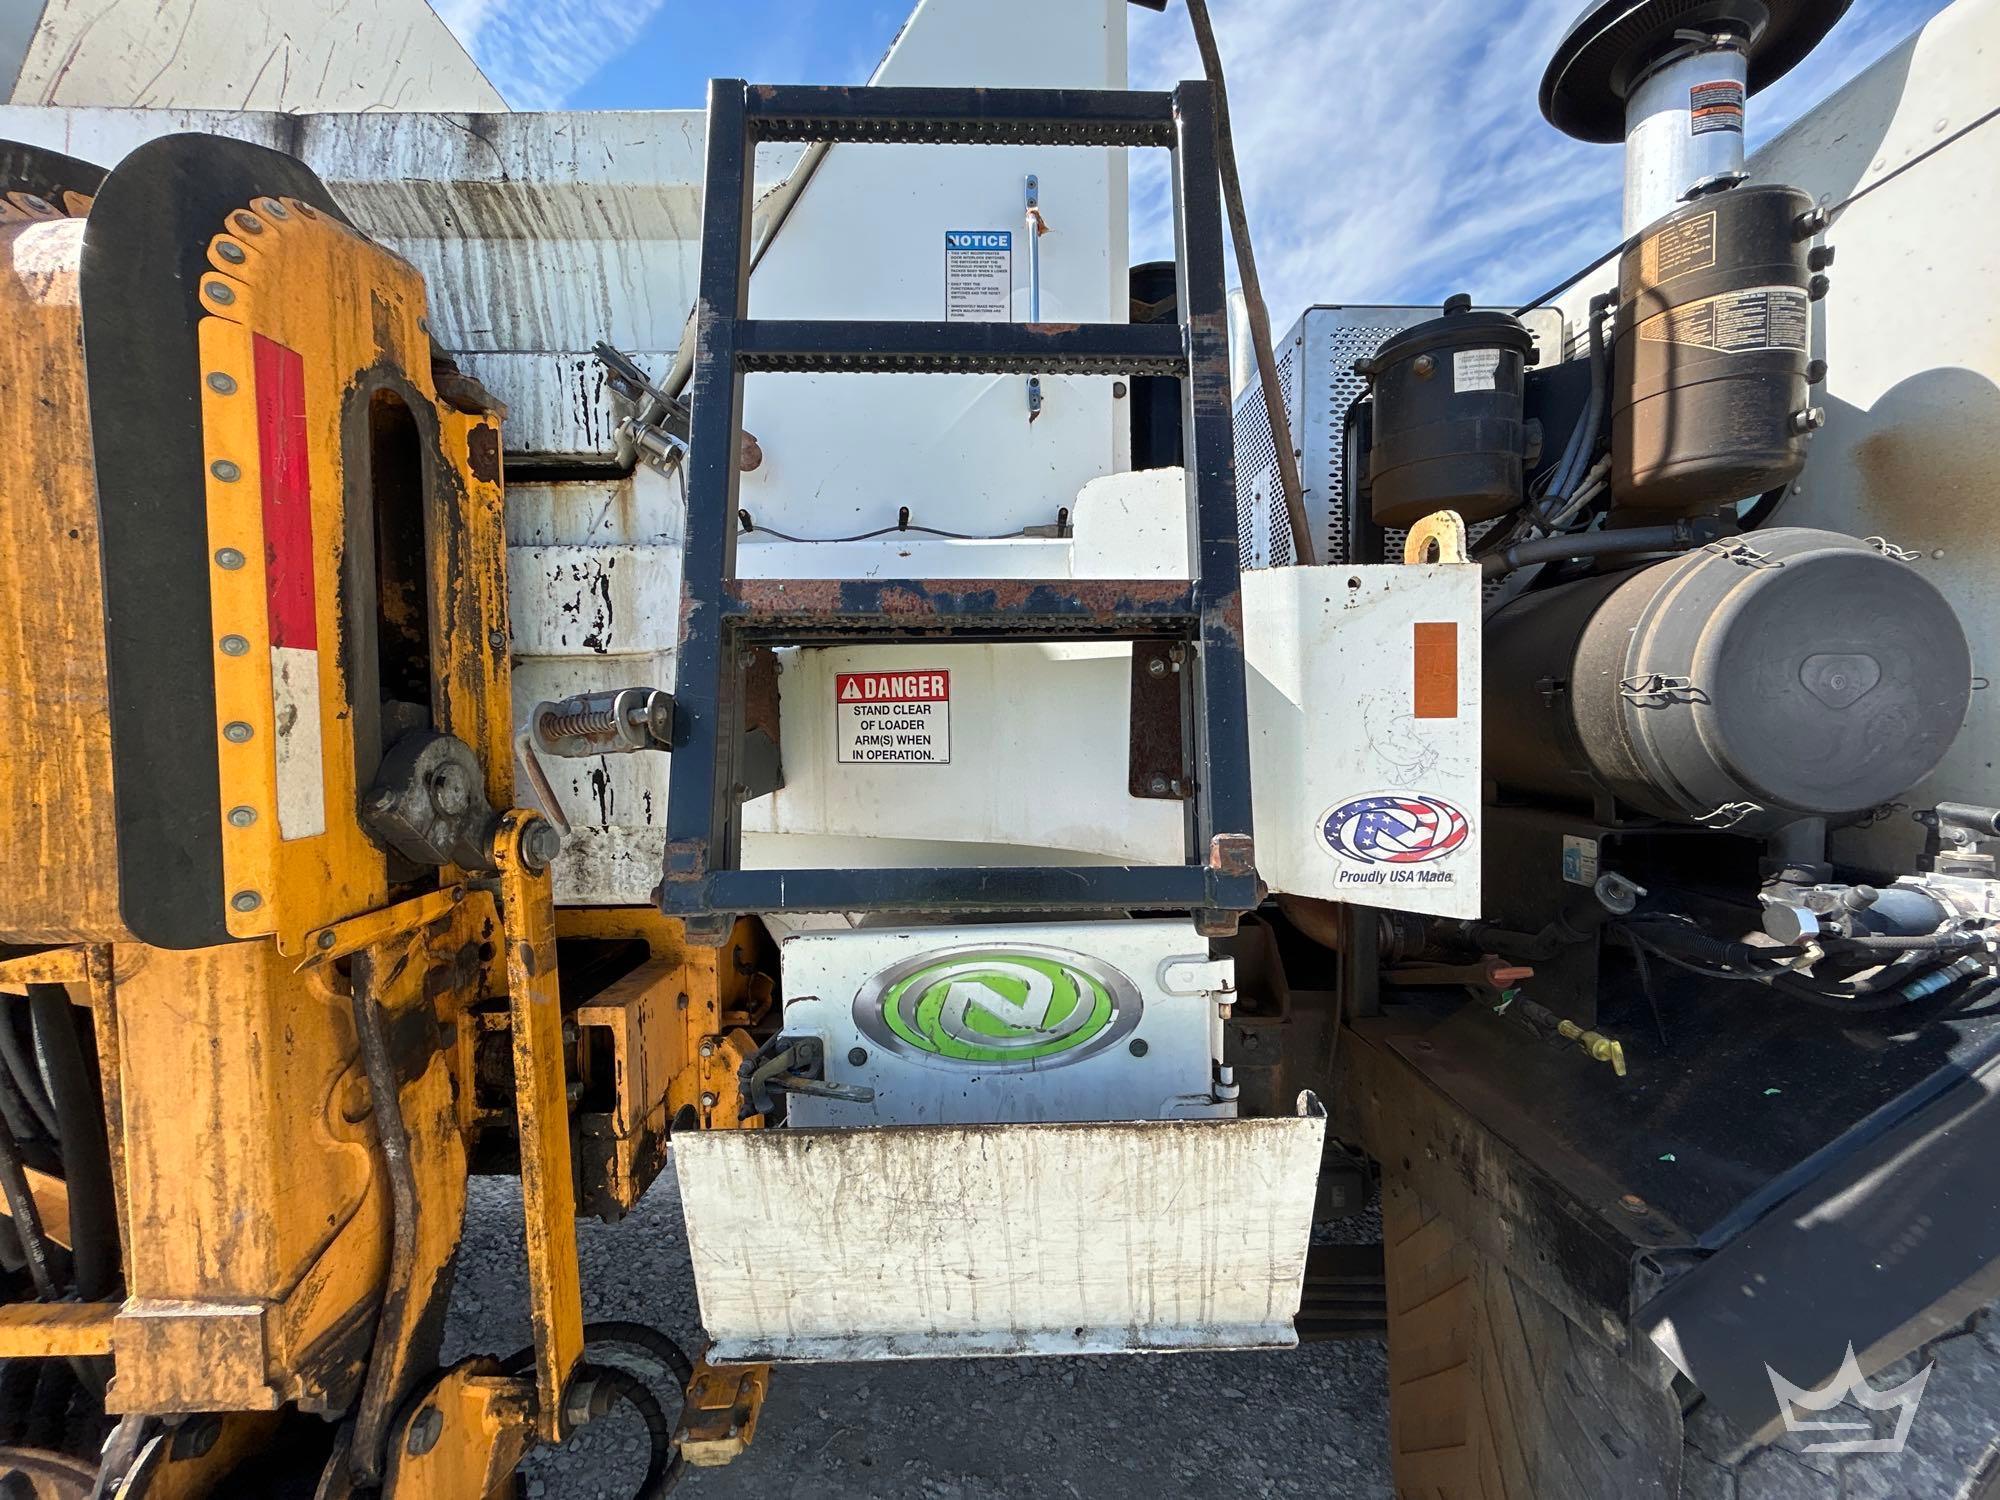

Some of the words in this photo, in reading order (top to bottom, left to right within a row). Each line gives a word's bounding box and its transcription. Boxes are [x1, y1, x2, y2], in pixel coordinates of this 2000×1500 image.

[948, 235, 1008, 247] NOTICE
[864, 675, 945, 699] DANGER
[853, 706, 890, 716] STAND
[893, 705, 931, 715] CLEAR
[860, 720, 875, 730] OF
[879, 720, 925, 730] LOADER
[855, 735, 893, 747] ARM(S)
[896, 735, 931, 745] WHEN
[852, 750, 863, 760] IN
[866, 750, 934, 760] OPERATION.
[1339, 870, 1386, 885] Proudly
[1390, 871, 1414, 882] USA
